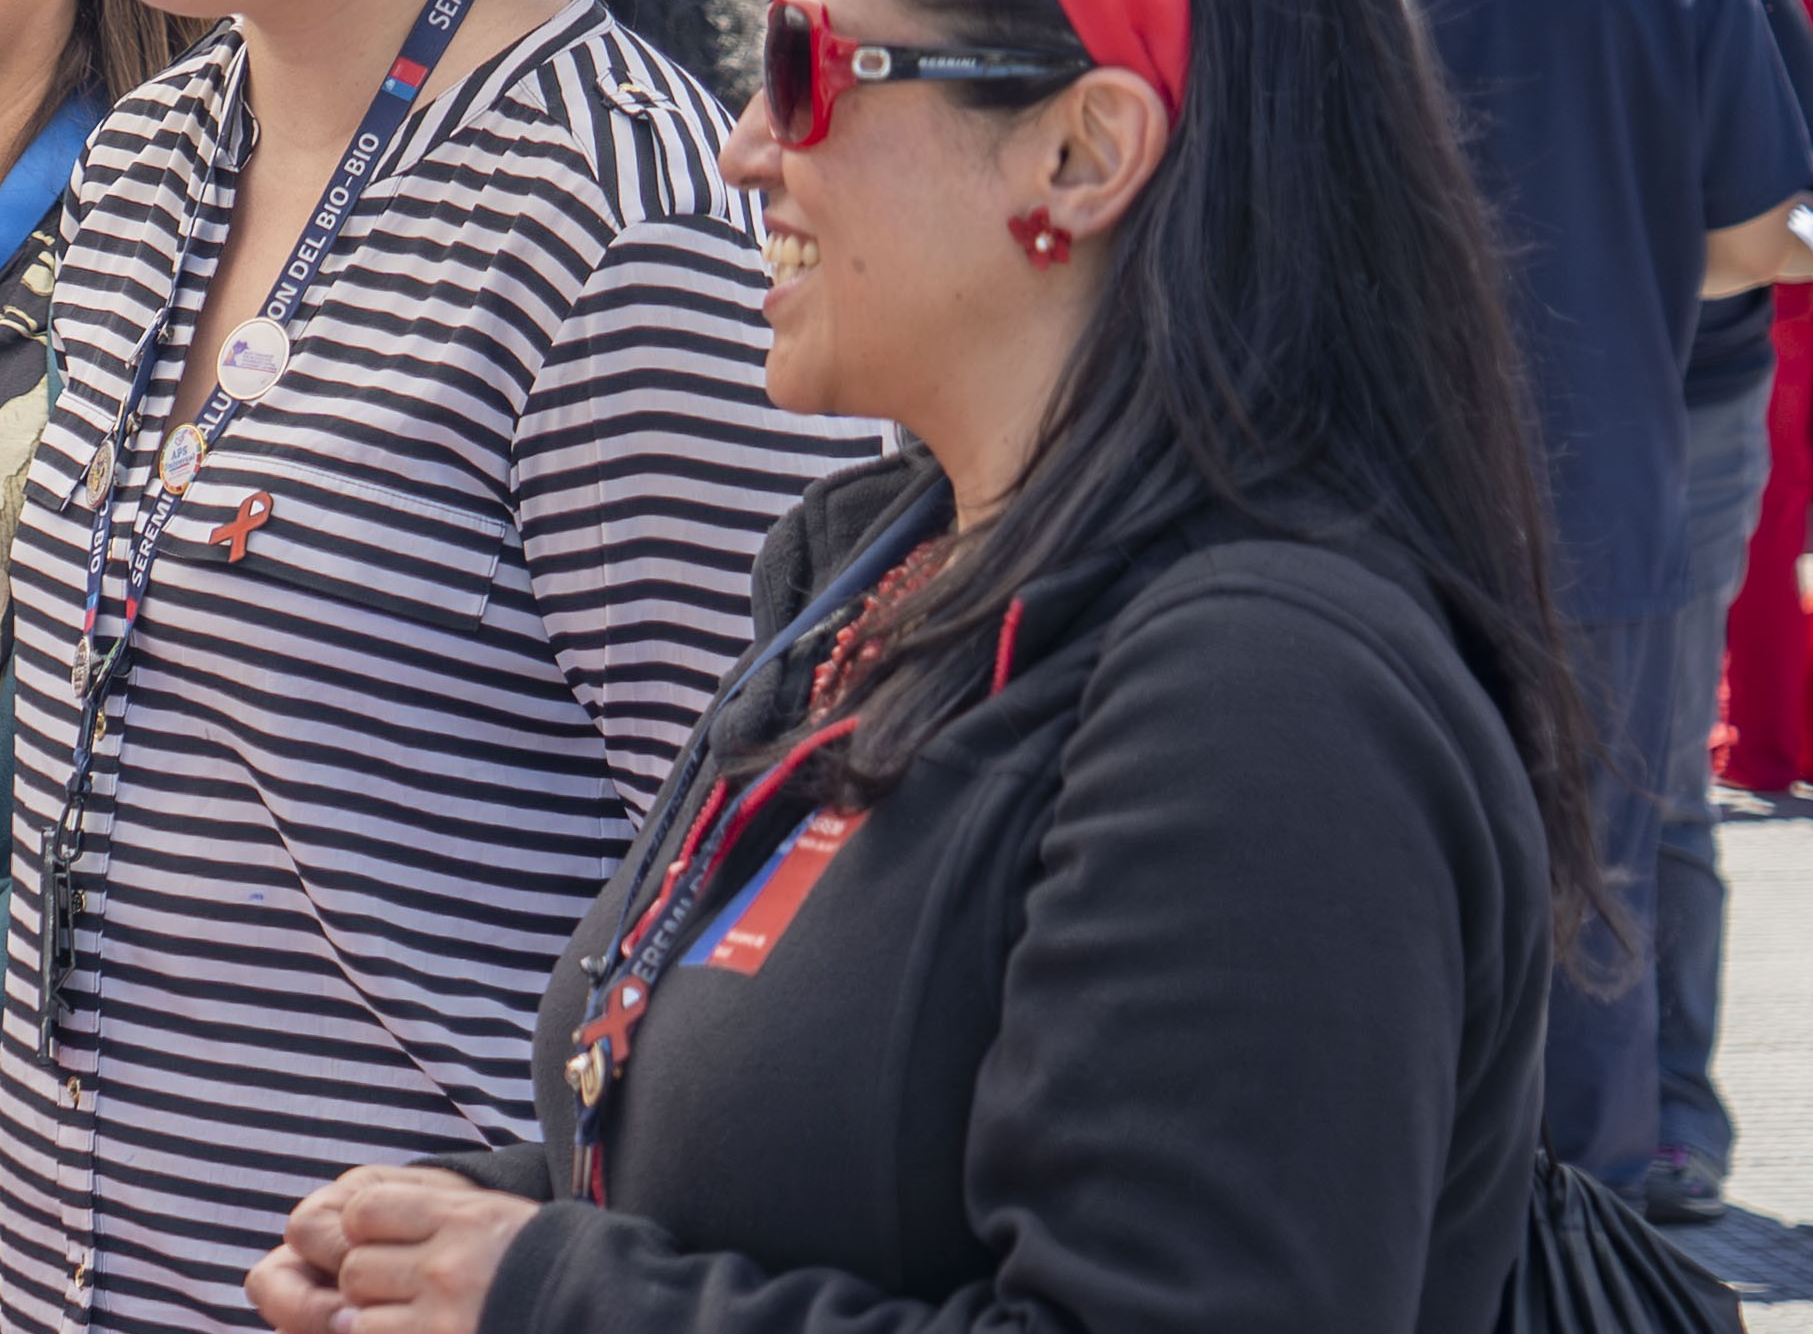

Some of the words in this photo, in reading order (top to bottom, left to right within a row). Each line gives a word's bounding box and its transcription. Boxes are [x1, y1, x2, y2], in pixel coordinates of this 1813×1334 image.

[288, 235, 326, 282] DEL
[315, 132, 380, 231] BIO-BIO
[130, 493, 174, 588] SEREMI
[632, 897, 692, 981] EREMI
